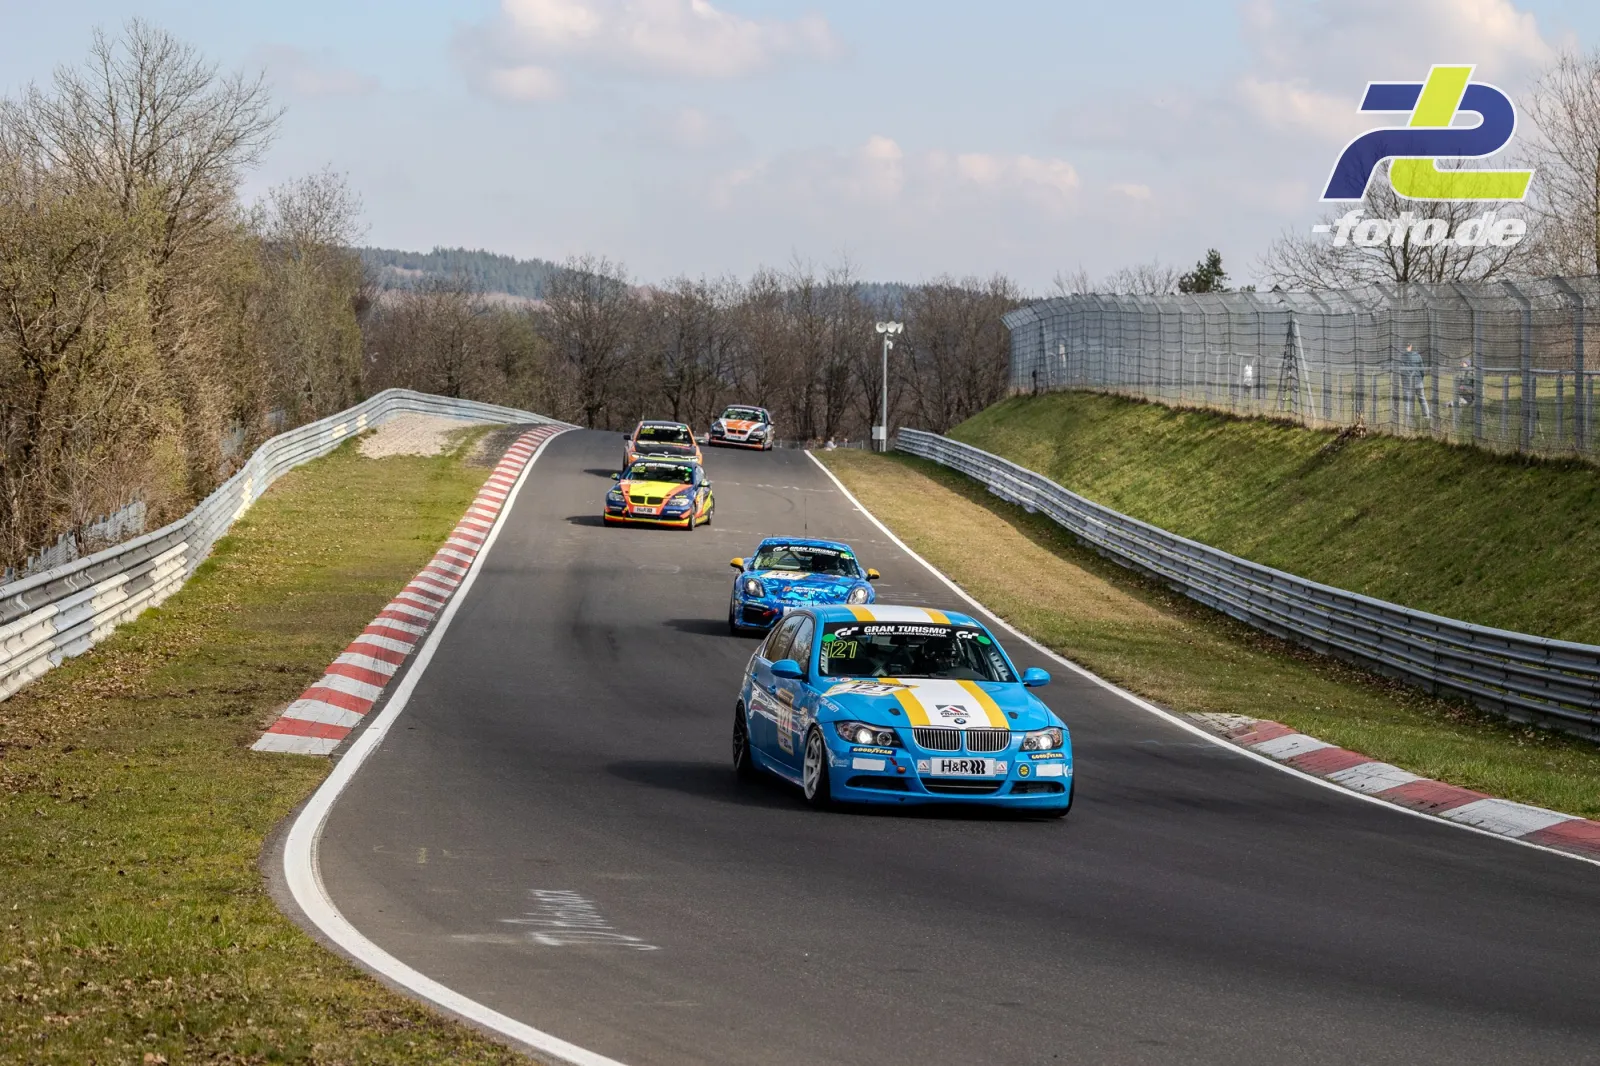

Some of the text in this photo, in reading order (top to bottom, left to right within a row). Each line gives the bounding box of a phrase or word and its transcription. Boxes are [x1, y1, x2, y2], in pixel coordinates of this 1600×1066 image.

[809, 547, 837, 555] TURISMO
[864, 625, 947, 635] GRAN TURISMO
[824, 640, 858, 658] 121
[851, 684, 894, 692] 121
[853, 747, 893, 755] GOODYEAR
[941, 759, 969, 773] H&R
